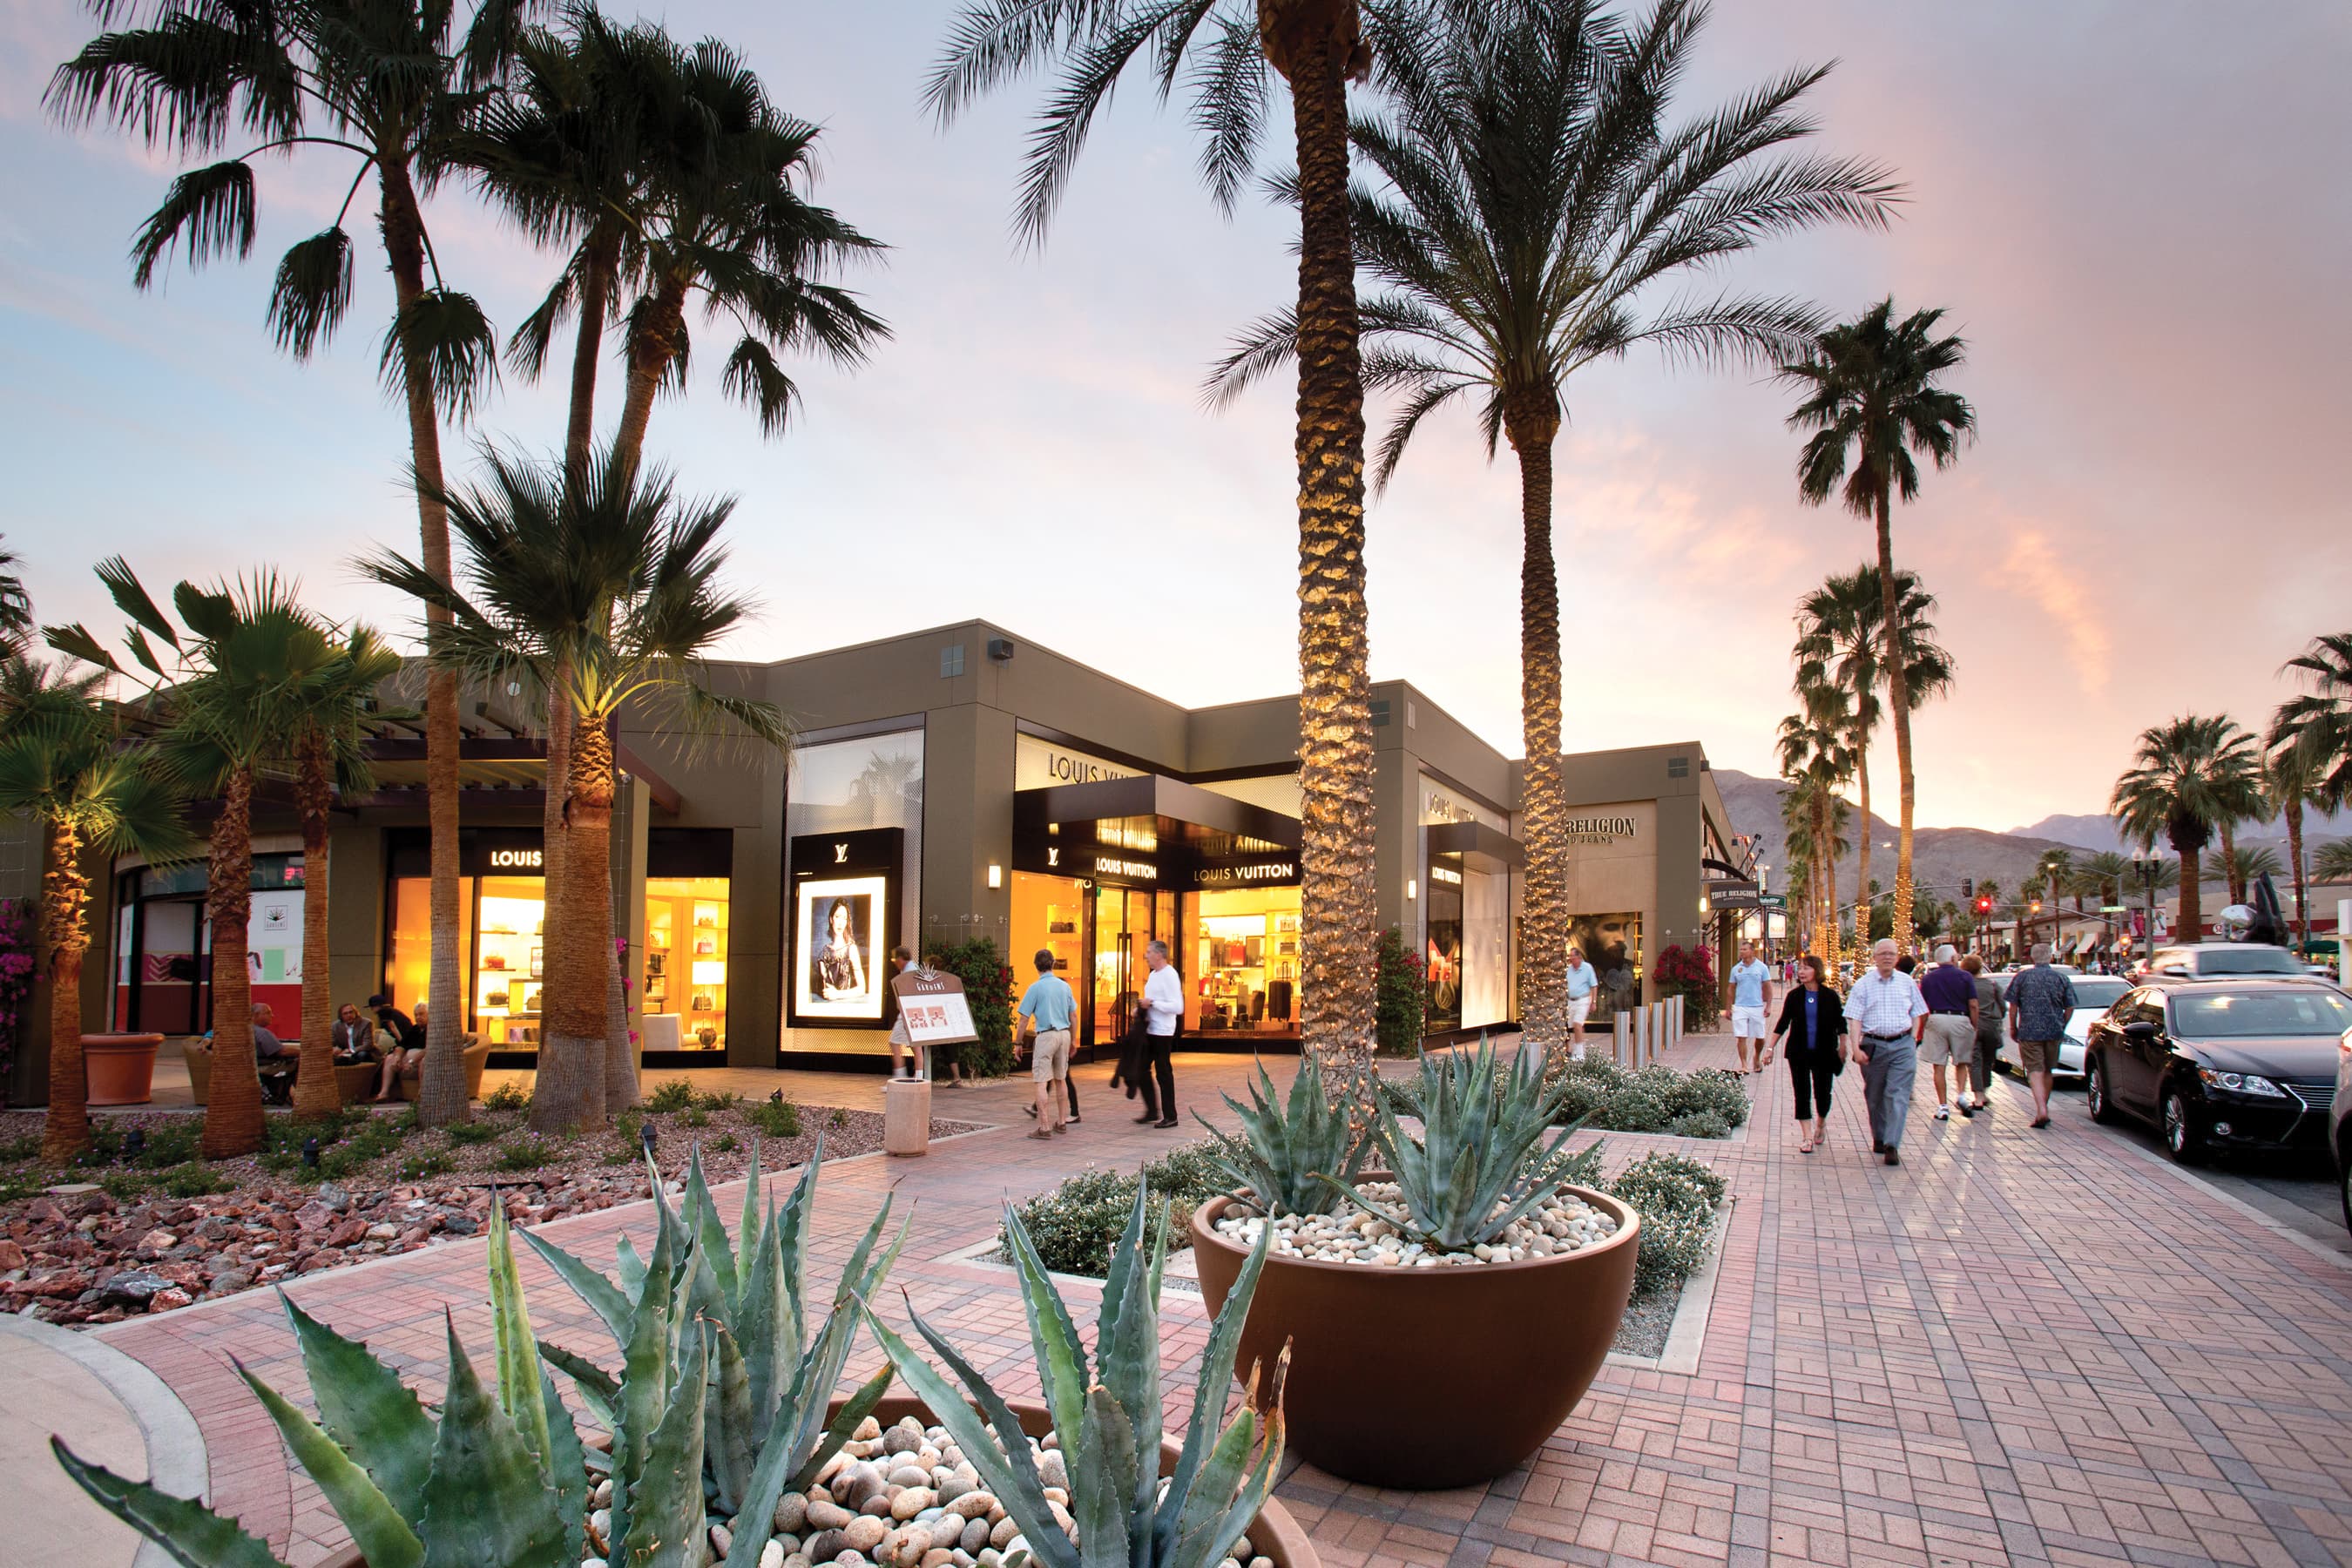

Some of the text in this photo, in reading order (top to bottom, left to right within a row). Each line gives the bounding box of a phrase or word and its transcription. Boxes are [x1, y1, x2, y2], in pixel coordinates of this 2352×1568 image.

[1050, 753, 1098, 784] LOUIS
[1565, 817, 1636, 837] RELIGION
[1580, 835, 1614, 844] JEANS
[491, 850, 542, 867] LOUIS
[1096, 857, 1157, 880] LOUIS VUITTON
[1193, 863, 1293, 882] LOUIS VUITTON
[1711, 890, 1727, 900] TRUE
[1728, 889, 1758, 898] RELIGION
